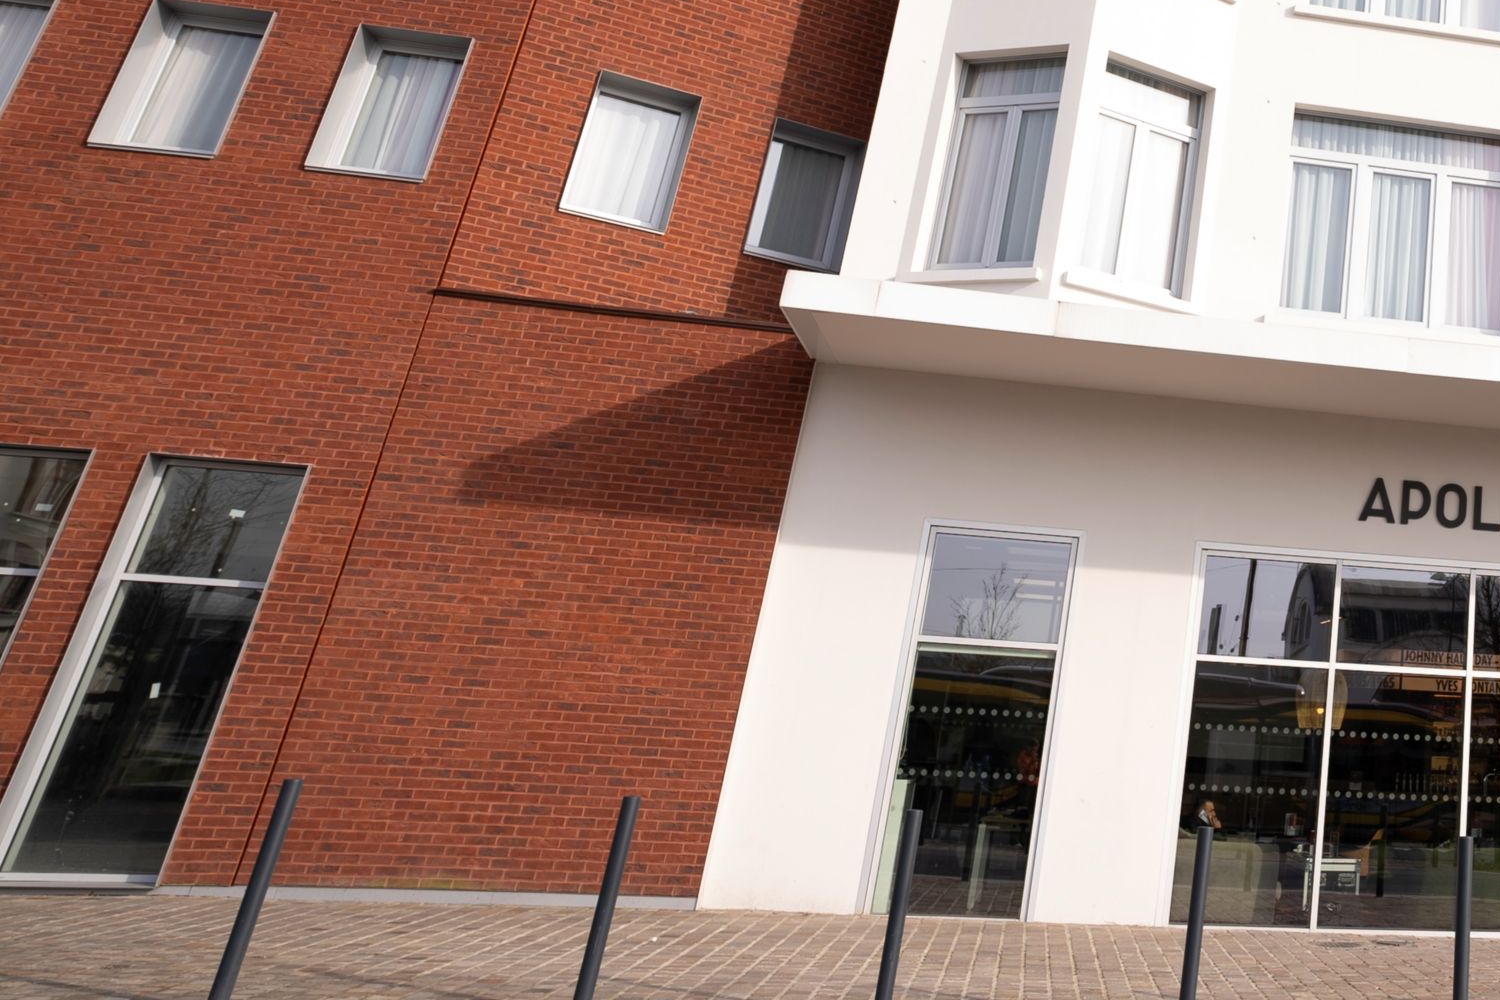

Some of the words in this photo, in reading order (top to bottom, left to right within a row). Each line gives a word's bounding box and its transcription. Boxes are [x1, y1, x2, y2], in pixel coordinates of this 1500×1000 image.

[1405, 650, 1442, 664] JOHNNY
[1446, 652, 1494, 667] HALDAY
[1435, 679, 1458, 691] YVES
